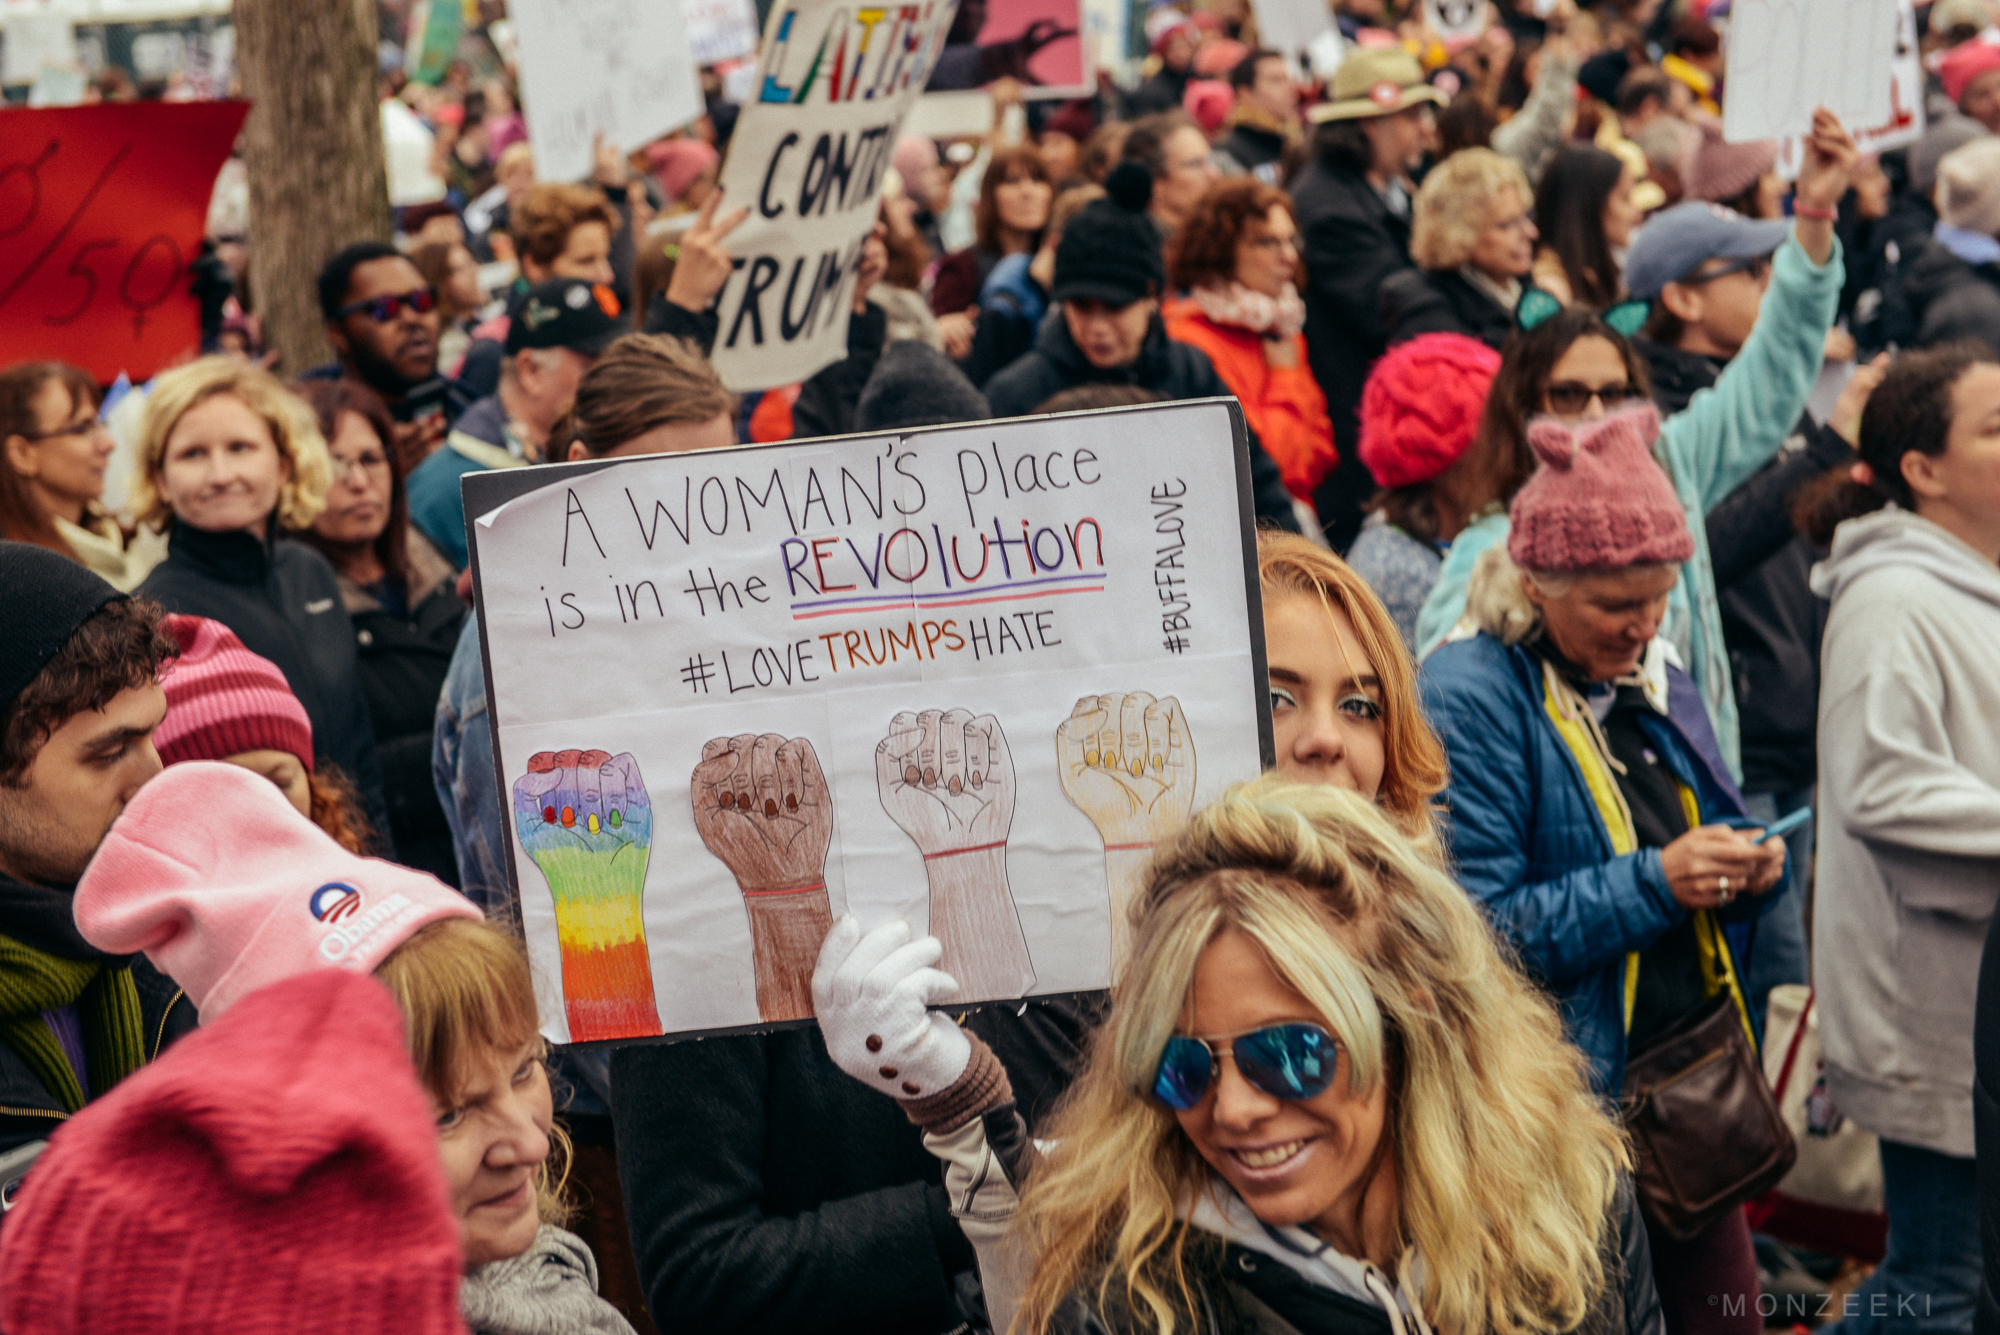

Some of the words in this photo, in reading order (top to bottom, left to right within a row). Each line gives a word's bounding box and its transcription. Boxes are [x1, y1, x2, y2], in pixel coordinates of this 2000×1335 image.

[562, 487, 607, 567] A
[624, 442, 927, 550] WOMAN'S
[957, 440, 1102, 529] place
[1150, 477, 1193, 655] #BUFFALOVE
[540, 585, 585, 638] is
[608, 574, 664, 623] in
[683, 567, 771, 617] the
